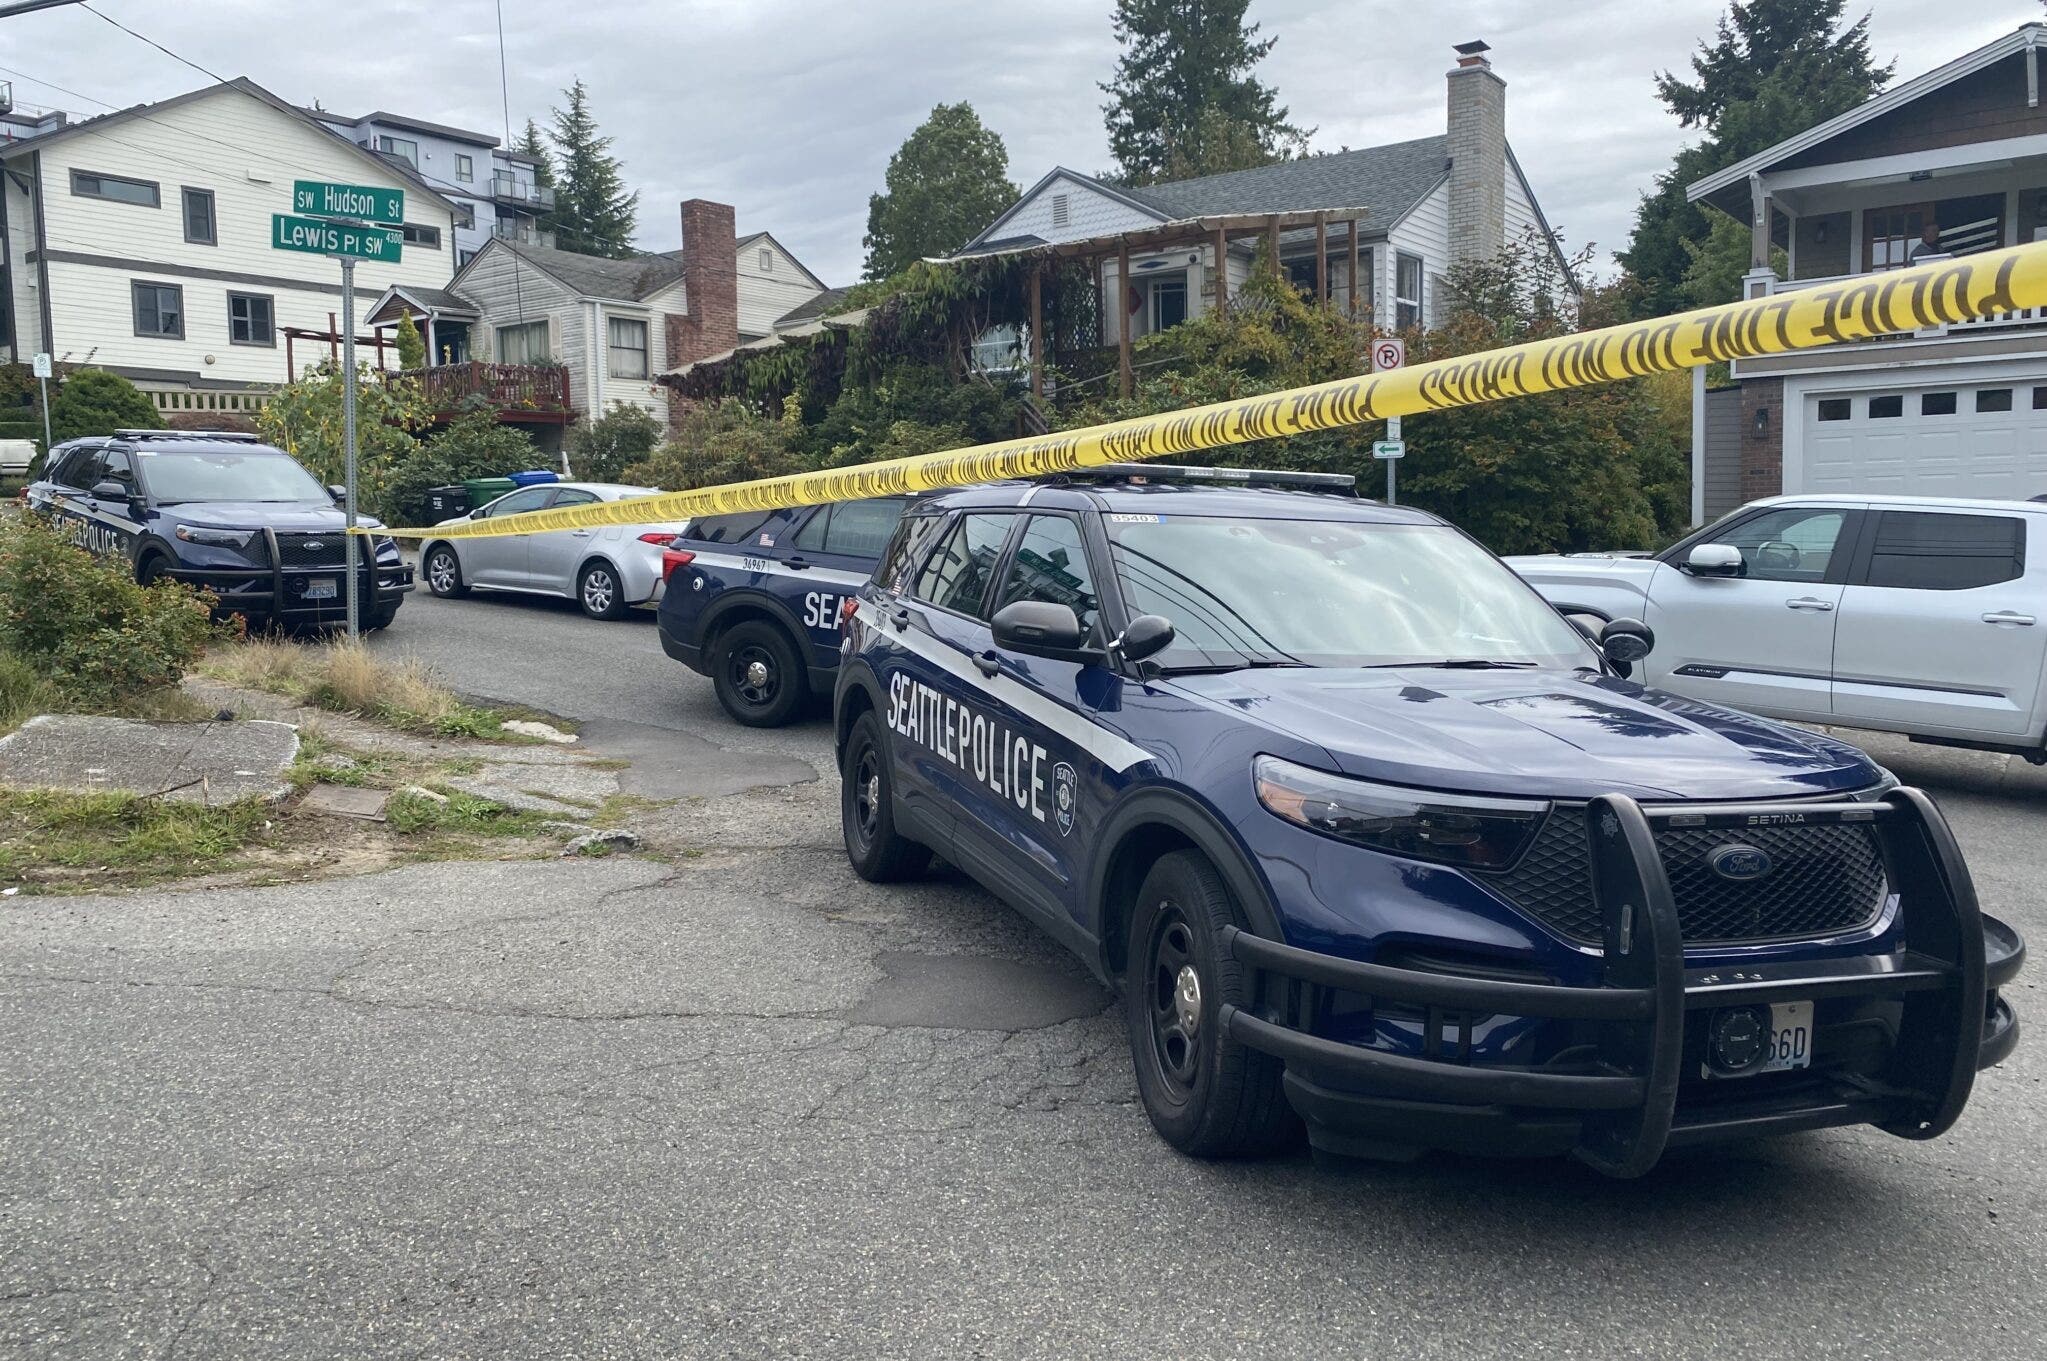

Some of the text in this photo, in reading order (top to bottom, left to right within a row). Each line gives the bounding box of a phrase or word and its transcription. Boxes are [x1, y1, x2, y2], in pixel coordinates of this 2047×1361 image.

[298, 185, 400, 218] SW Hudson St
[280, 217, 402, 255] Lewis Pl SW 4300
[887, 671, 1047, 823] SEATTLE POLICE
[1056, 767, 1074, 788] SEATTLE
[1057, 807, 1070, 827] POLICE
[1747, 813, 1805, 825] SETINA
[1729, 854, 1760, 873] Ford
